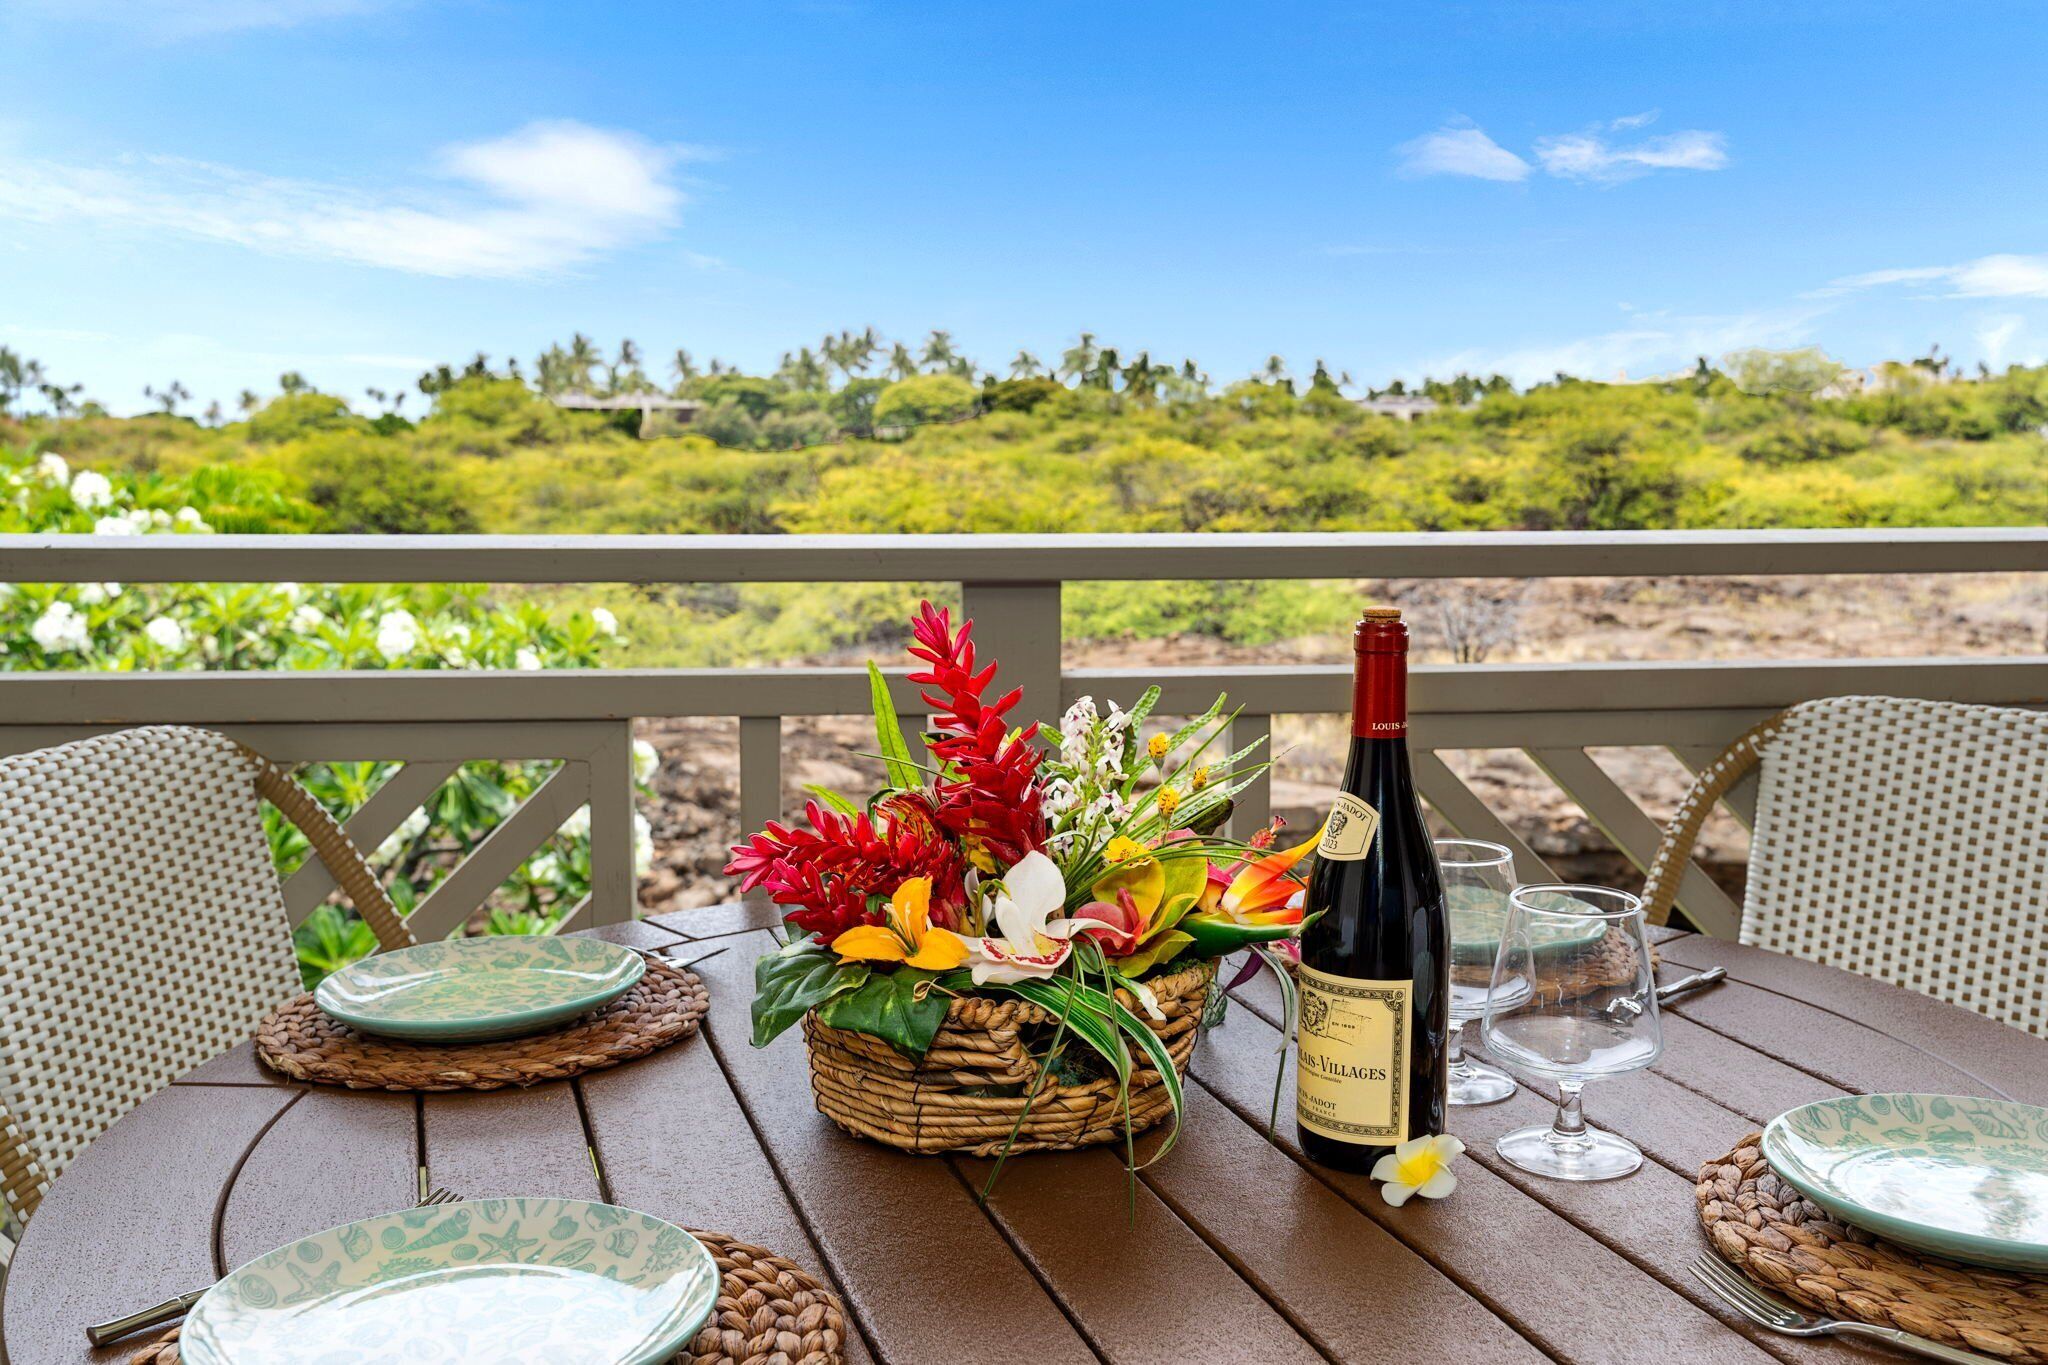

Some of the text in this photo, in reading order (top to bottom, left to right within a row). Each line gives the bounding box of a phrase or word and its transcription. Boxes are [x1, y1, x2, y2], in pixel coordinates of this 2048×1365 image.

[1372, 722, 1400, 731] LOUIS
[1341, 802, 1369, 822] JADOT
[1298, 1048, 1387, 1081] LAIS-VILLAGES
[1309, 1096, 1337, 1111] JADOT
